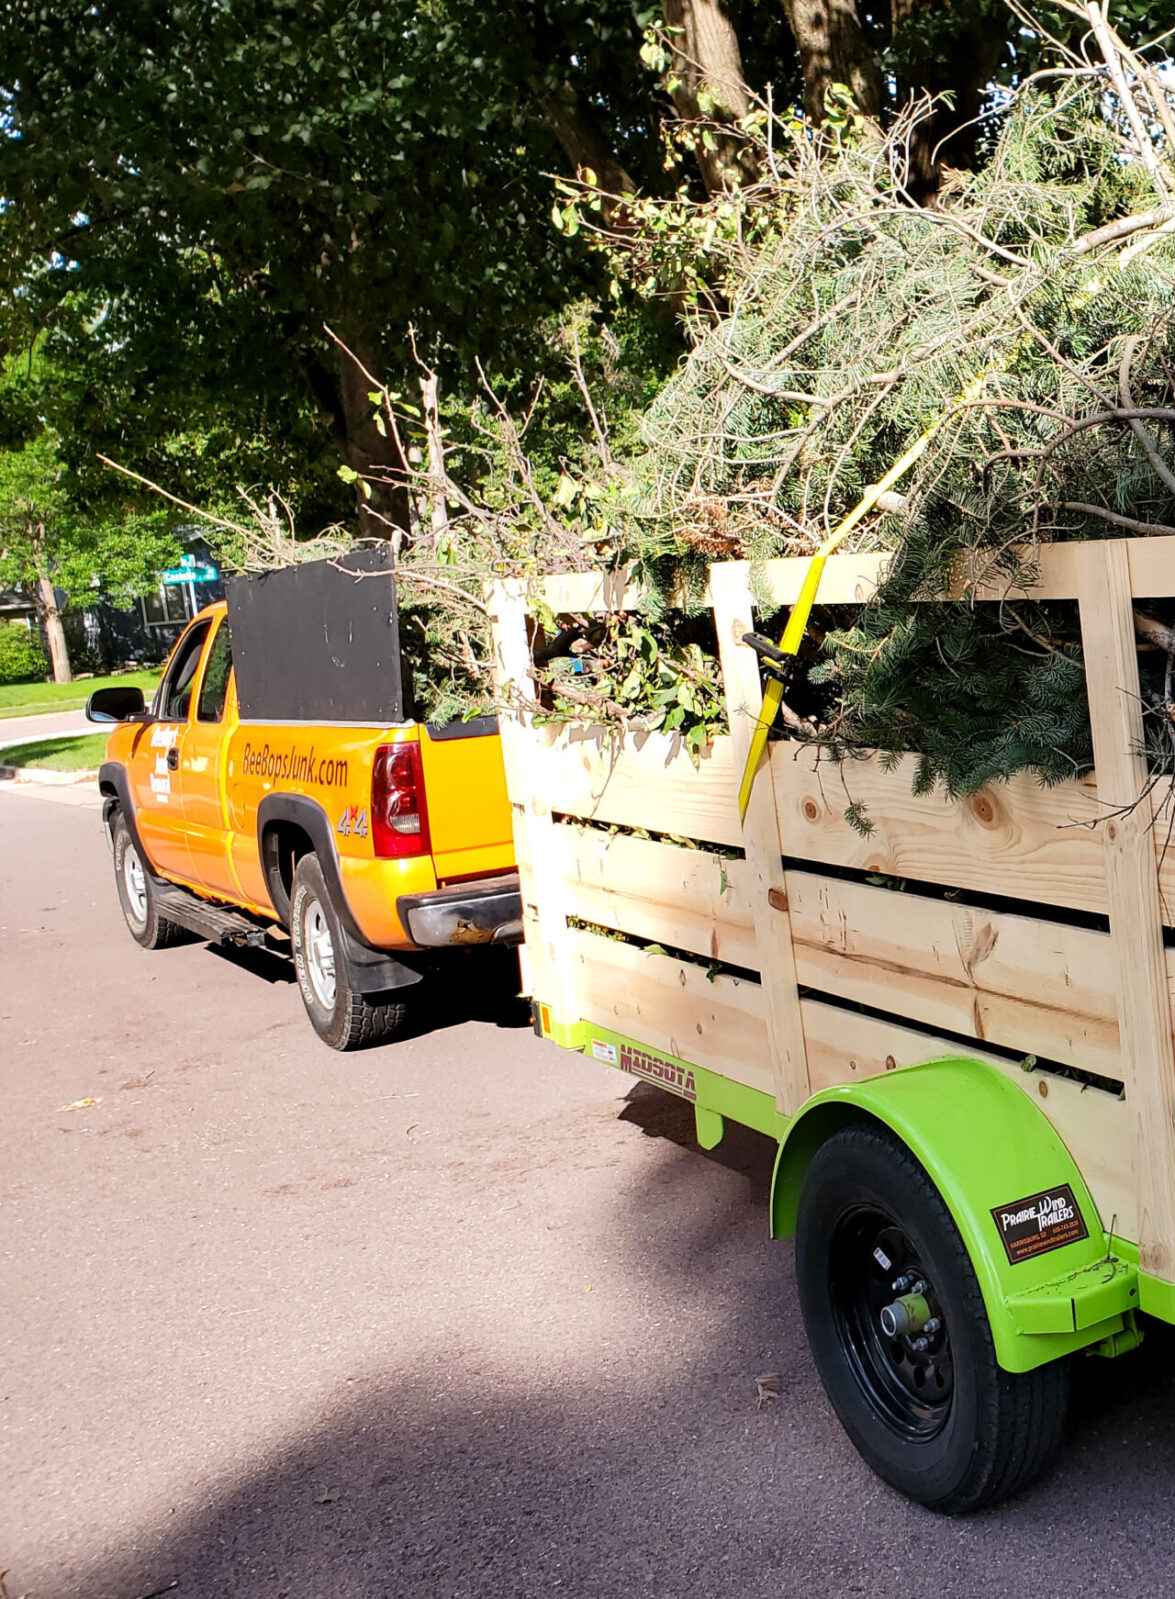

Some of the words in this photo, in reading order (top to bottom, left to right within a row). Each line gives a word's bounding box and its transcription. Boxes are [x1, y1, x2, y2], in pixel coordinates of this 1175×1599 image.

[243, 742, 348, 787] BeeBopsJunk.com
[620, 1043, 697, 1092] MIDSOTA
[1001, 1206, 1037, 1232] PRAIRIE
[1038, 1196, 1067, 1216] WIND
[1034, 1206, 1074, 1232] TRAILERS
